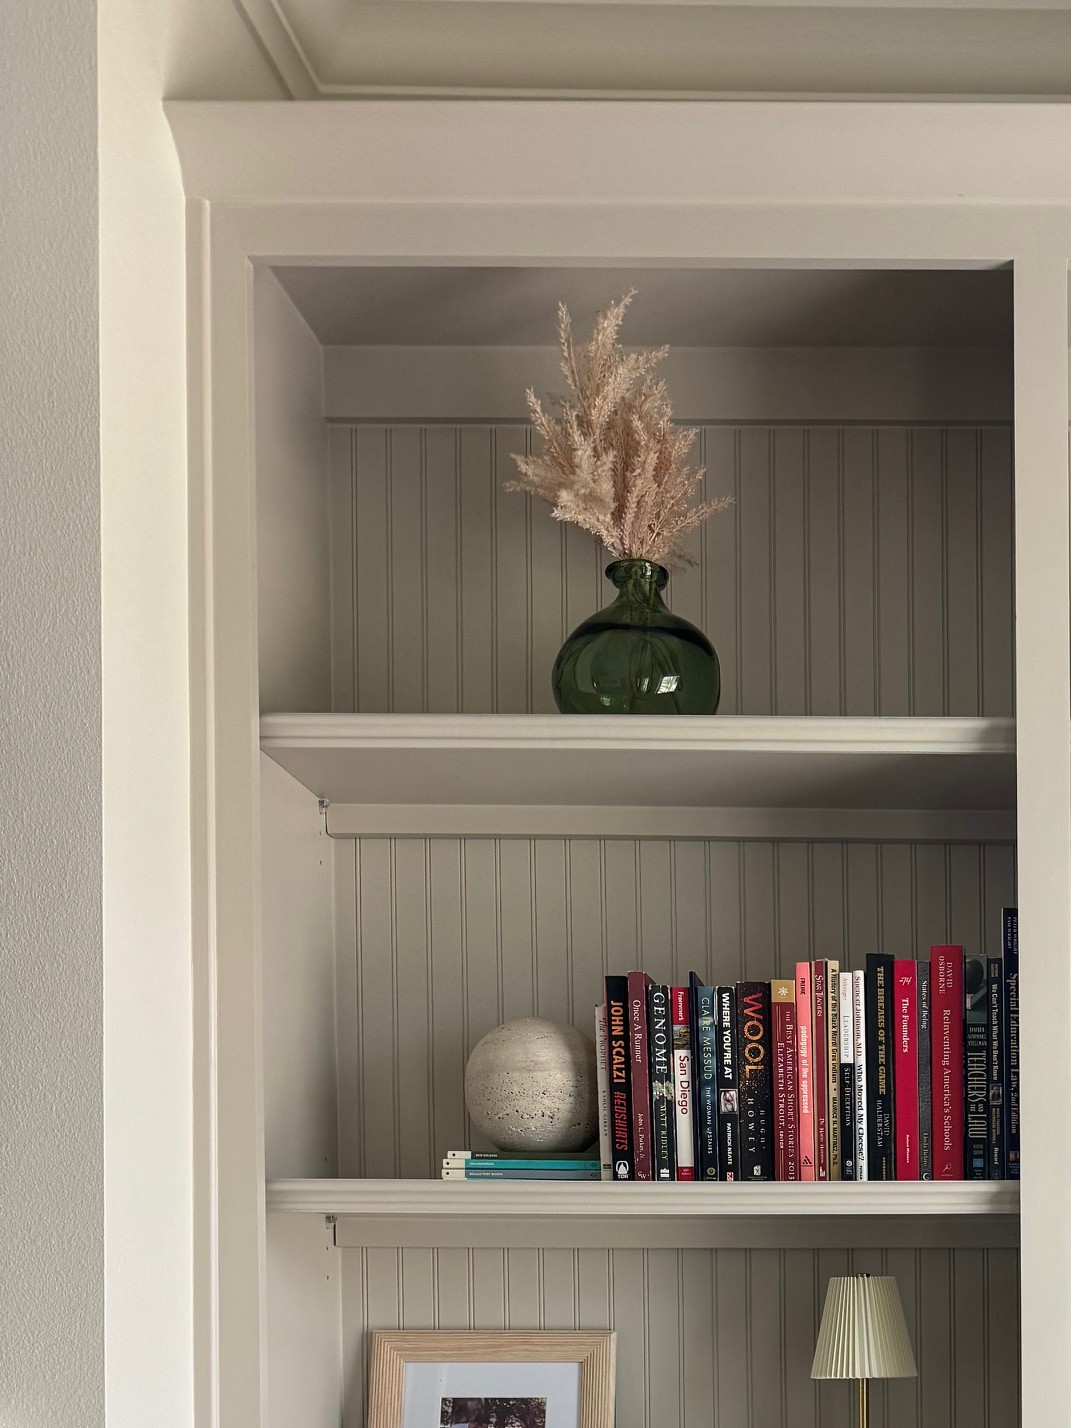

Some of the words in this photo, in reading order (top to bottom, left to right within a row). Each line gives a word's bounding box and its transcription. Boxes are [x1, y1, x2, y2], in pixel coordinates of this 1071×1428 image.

[901, 998, 909, 1013] The
[992, 984, 998, 995] We
[1010, 972, 1019, 1011] Special
[610, 1000, 623, 1036] JOHN
[632, 1000, 641, 1022] Once
[701, 997, 711, 1031] CLAIRE
[877, 988, 885, 1028] BREAKS
[634, 1022, 641, 1031] A
[653, 992, 667, 1074] GENOME
[743, 992, 764, 1080] WOOL
[878, 1030, 885, 1044] OF
[942, 1009, 951, 1066] Reinventing
[1010, 1013, 1019, 1066] Education
[612, 1040, 626, 1083] SCALZI
[703, 1036, 712, 1080] MESSUD
[722, 1030, 731, 1066] YOU'RE
[992, 1041, 998, 1050] We
[679, 1055, 690, 1076] San
[724, 1067, 732, 1080] AT
[967, 1050, 987, 1102] TEACHERS
[1011, 1068, 1019, 1090] Law,
[678, 1080, 690, 1115] Diego
[614, 1092, 628, 1150] REDSHIRTS
[748, 1098, 756, 1153] HOWEY
[944, 1115, 952, 1151] Schools
[968, 1113, 987, 1139] LAW
